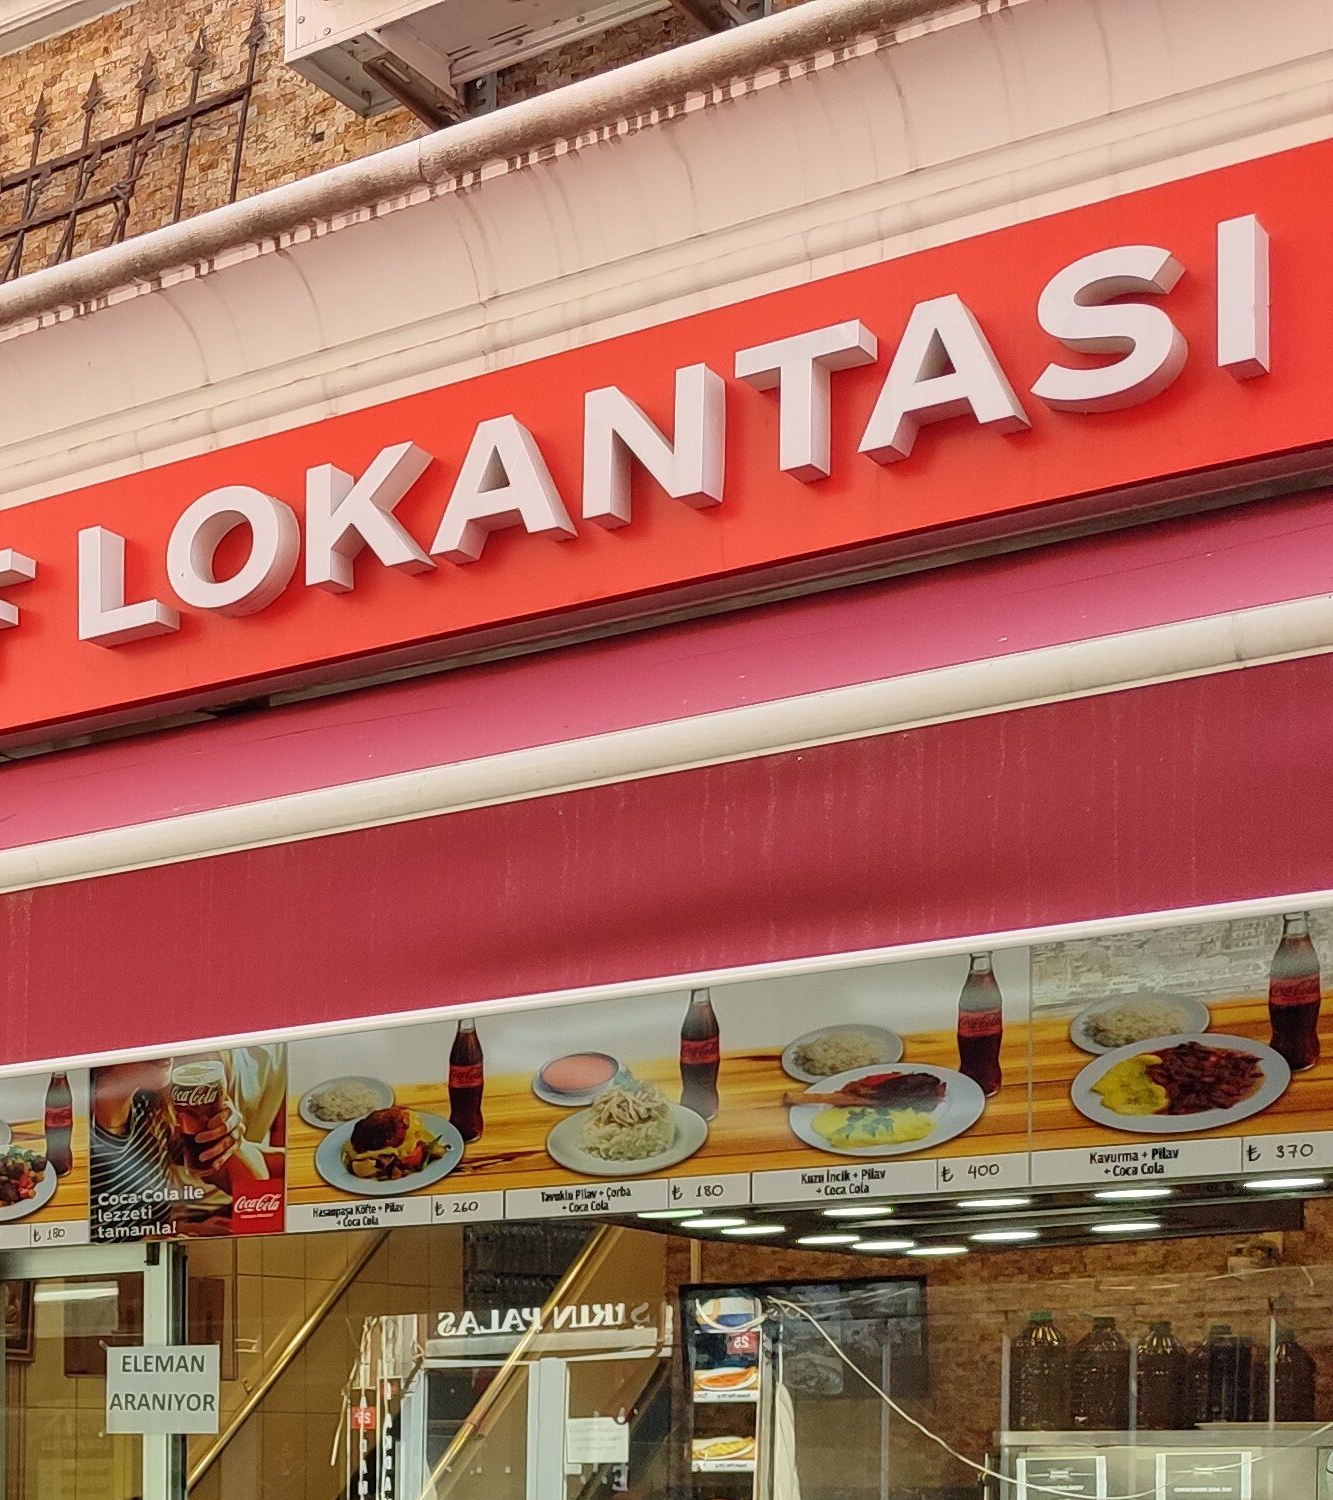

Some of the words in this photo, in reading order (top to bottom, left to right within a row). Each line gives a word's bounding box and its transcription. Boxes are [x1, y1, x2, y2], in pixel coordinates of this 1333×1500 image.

[77, 212, 1272, 649] LOKANTASI
[1090, 1150, 1139, 1165] Kavurma
[1152, 1147, 1179, 1161] Pilav
[1276, 1142, 1314, 1158] 370
[860, 1167, 886, 1180] Pilav
[967, 1163, 1000, 1177] 400
[1113, 1164, 1137, 1177] Coca
[1140, 1162, 1165, 1175] Cola
[183, 1186, 205, 1200] ile
[695, 1184, 724, 1197] 180
[823, 1184, 844, 1196] Coca
[847, 1182, 870, 1195] Cola
[234, 1193, 282, 1213] Coca-Cola
[452, 1200, 478, 1213] 260
[568, 1201, 587, 1213] Coca
[590, 1200, 609, 1212] Cola
[97, 1205, 153, 1222] lezzeti
[341, 1217, 360, 1228] Coca
[361, 1215, 379, 1227] Cola
[46, 1227, 65, 1240] 180
[97, 1221, 177, 1239] tamamla!
[121, 1354, 205, 1374] ELEMAN
[109, 1393, 215, 1412] ARANIYOR
